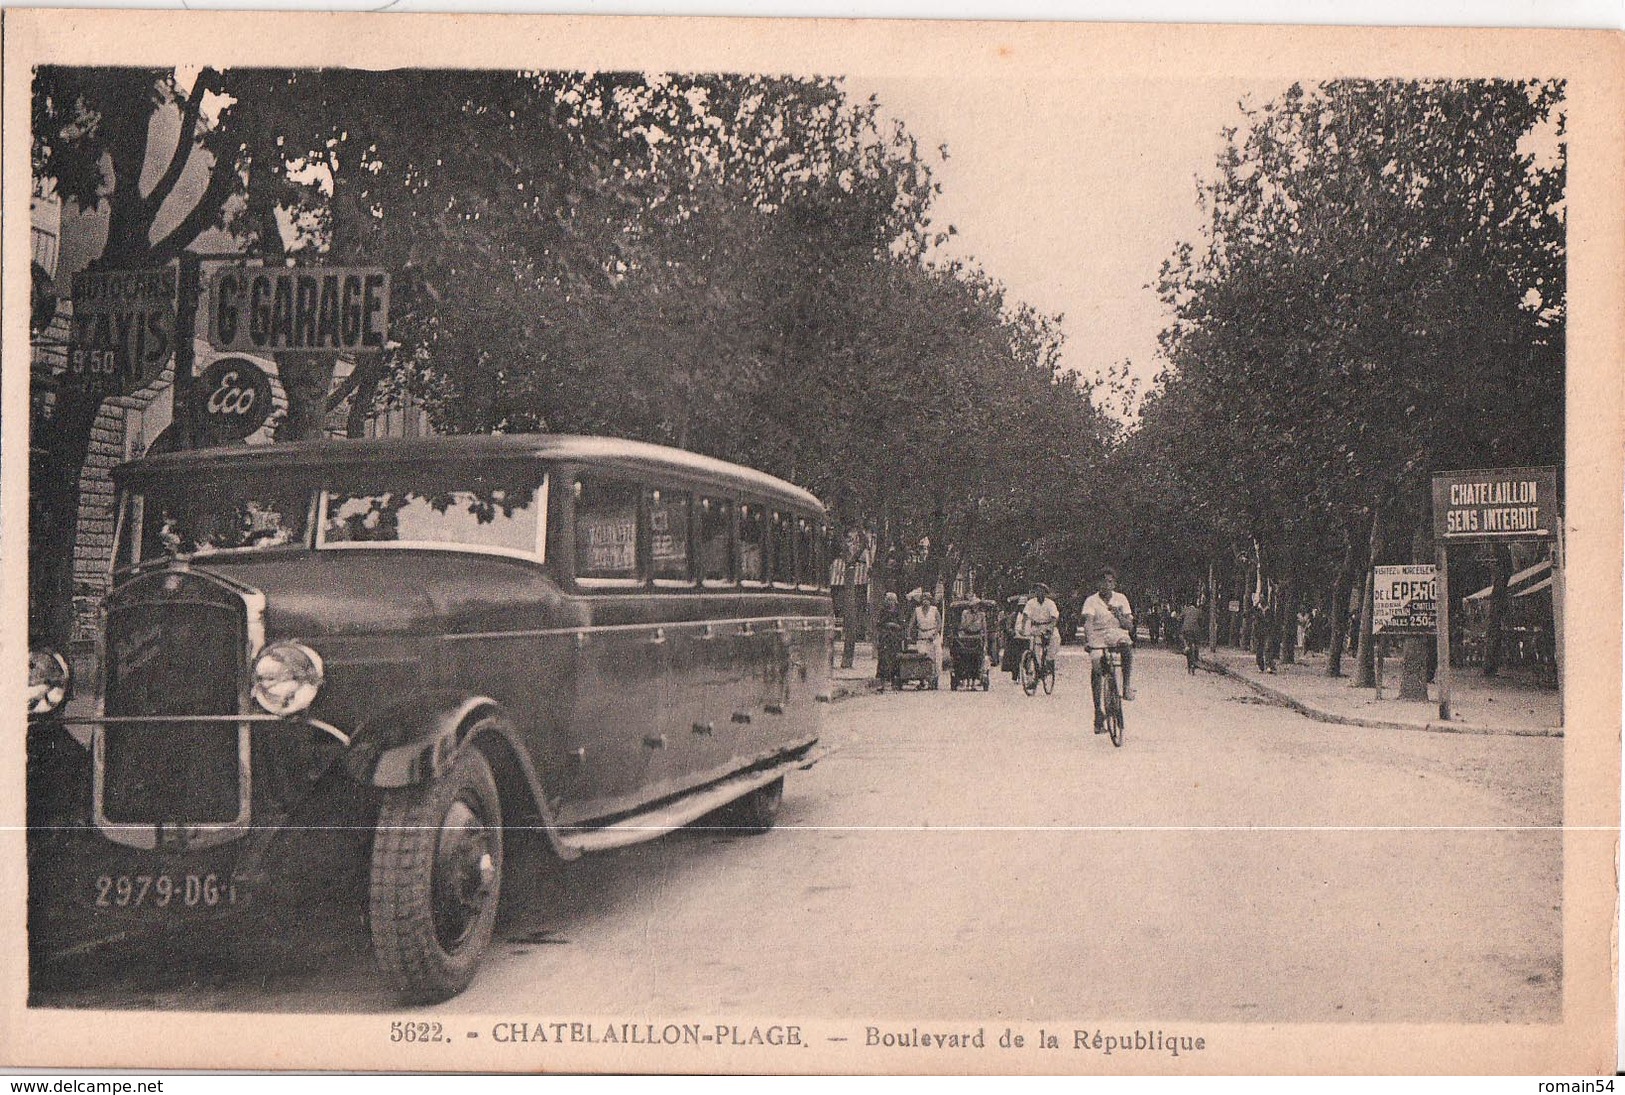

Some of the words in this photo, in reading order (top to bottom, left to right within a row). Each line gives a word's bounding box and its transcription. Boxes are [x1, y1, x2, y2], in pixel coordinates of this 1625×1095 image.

[250, 274, 384, 347] GARAGE
[75, 311, 168, 381] TAXIS
[208, 371, 255, 415] Eco
[1451, 481, 1537, 505] CHATELAILLON
[1447, 510, 1478, 531] SENS
[1483, 507, 1538, 531] INTERDIT
[1392, 580, 1437, 600] EPERO
[1410, 616, 1428, 626] 250
